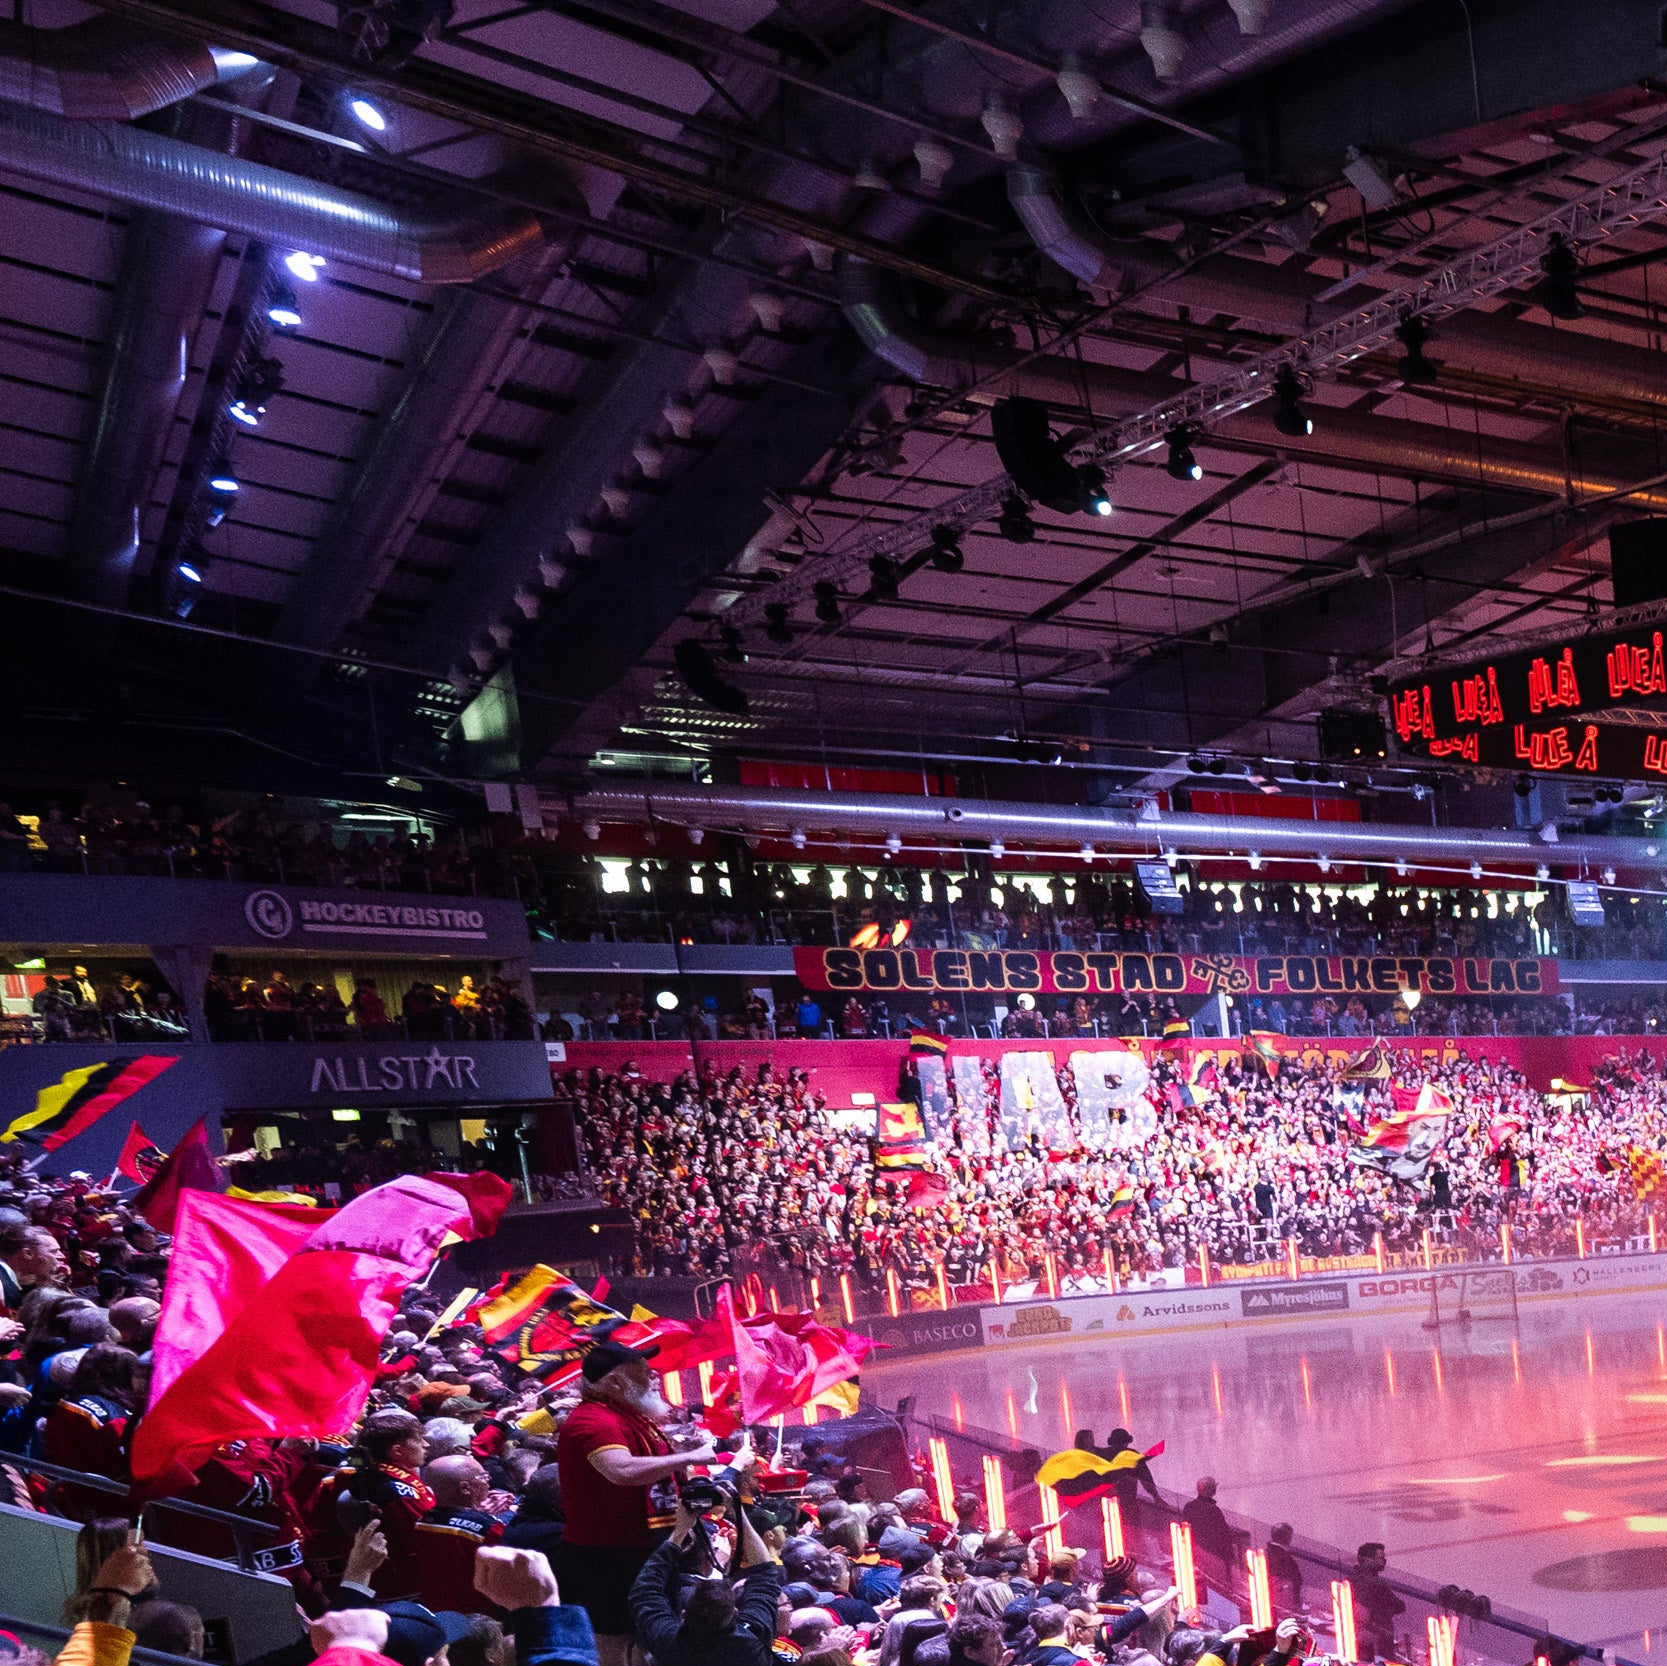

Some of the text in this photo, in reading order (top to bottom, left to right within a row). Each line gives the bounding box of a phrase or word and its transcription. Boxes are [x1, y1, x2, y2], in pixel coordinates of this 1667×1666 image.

[1607, 632, 1667, 698] LULEÅ
[1514, 724, 1598, 772] LULEÅ
[299, 900, 484, 929] HOCKEYBISTRO
[823, 948, 1542, 994] SOLENS STAD FOLKETS LAG
[309, 1045, 480, 1092] ALLSTAR
[1359, 1275, 1459, 1297] BORGA
[1143, 1302, 1230, 1317] Arvidssons
[913, 1323, 976, 1343] BASECO
